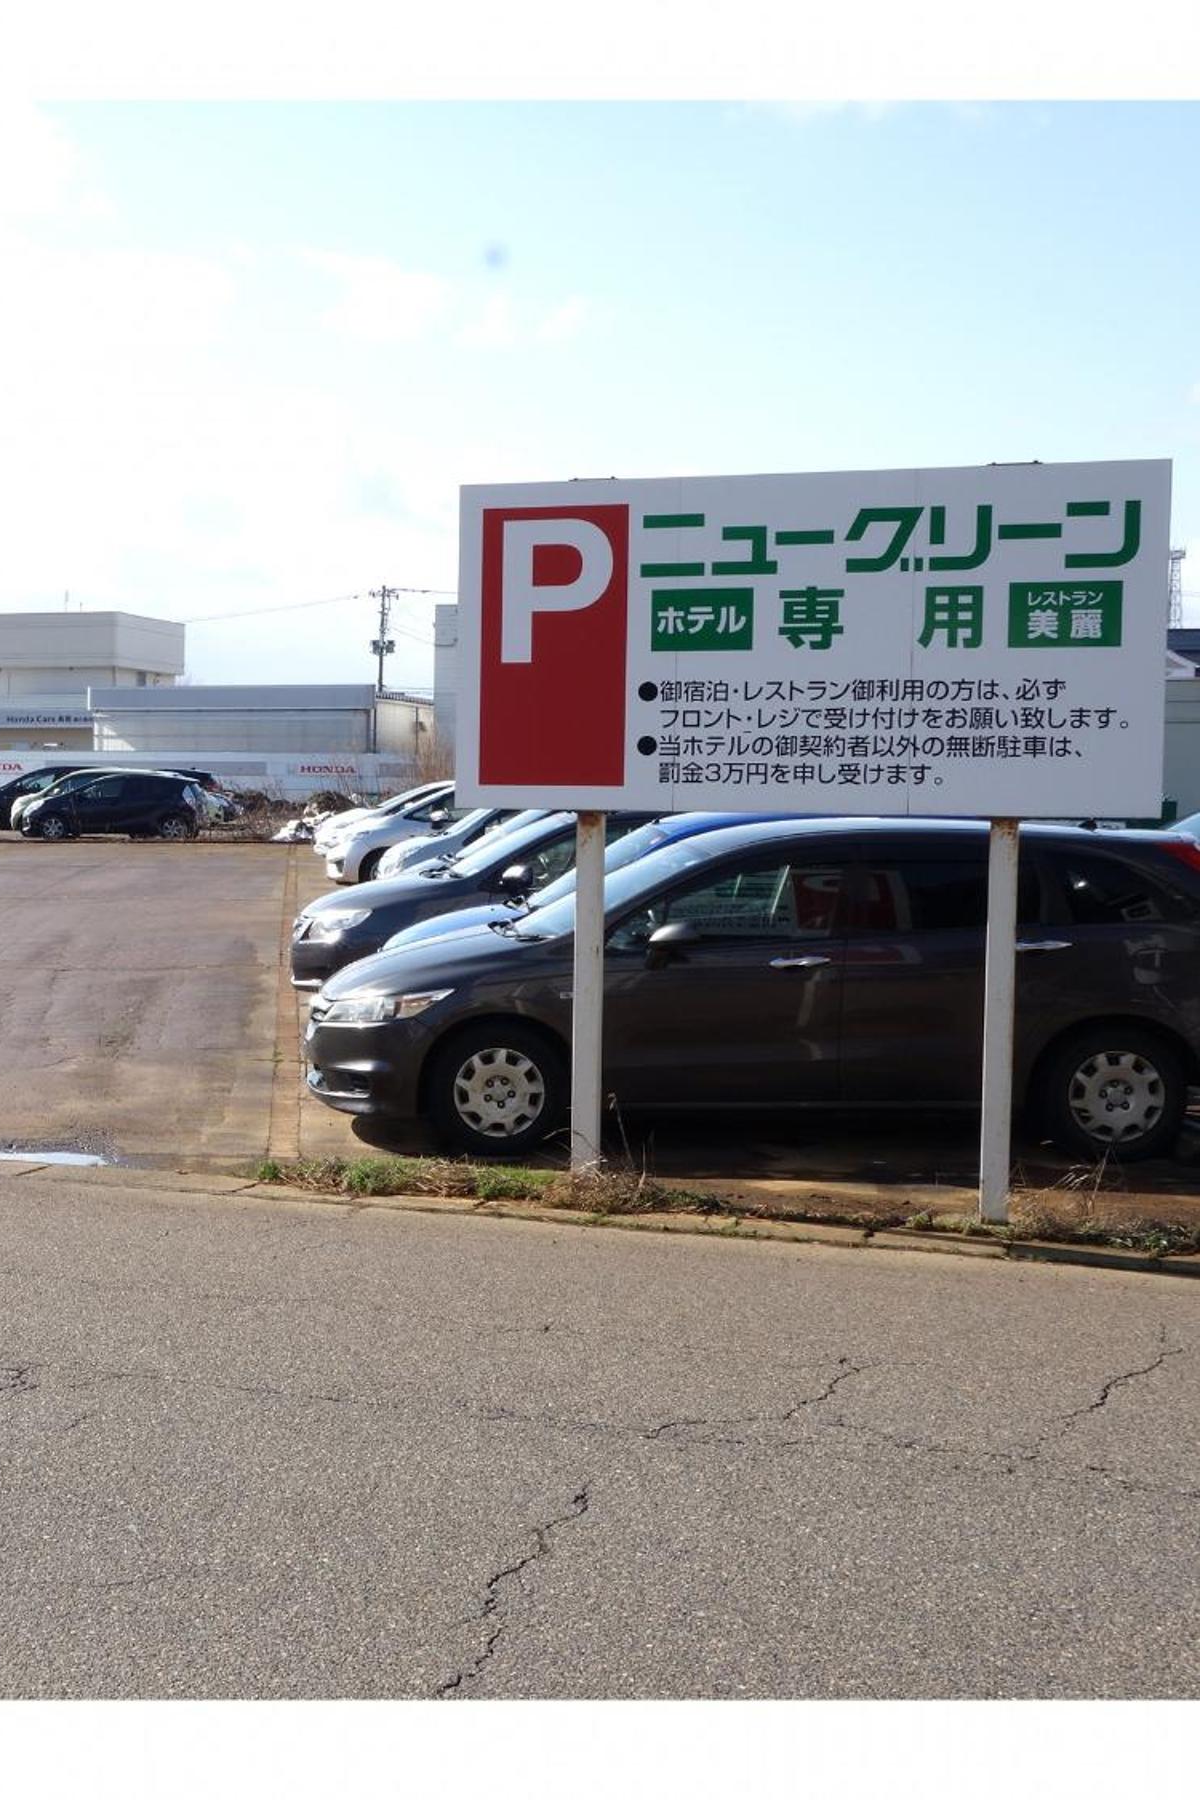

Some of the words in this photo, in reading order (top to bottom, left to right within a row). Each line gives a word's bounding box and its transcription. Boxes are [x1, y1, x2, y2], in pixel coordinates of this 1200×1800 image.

[640, 500, 1142, 578] ニューグリーン
[500, 518, 614, 664] P
[1027, 591, 1104, 607] レストラン
[656, 606, 747, 635] ホテル
[300, 765, 356, 774] HONDA
